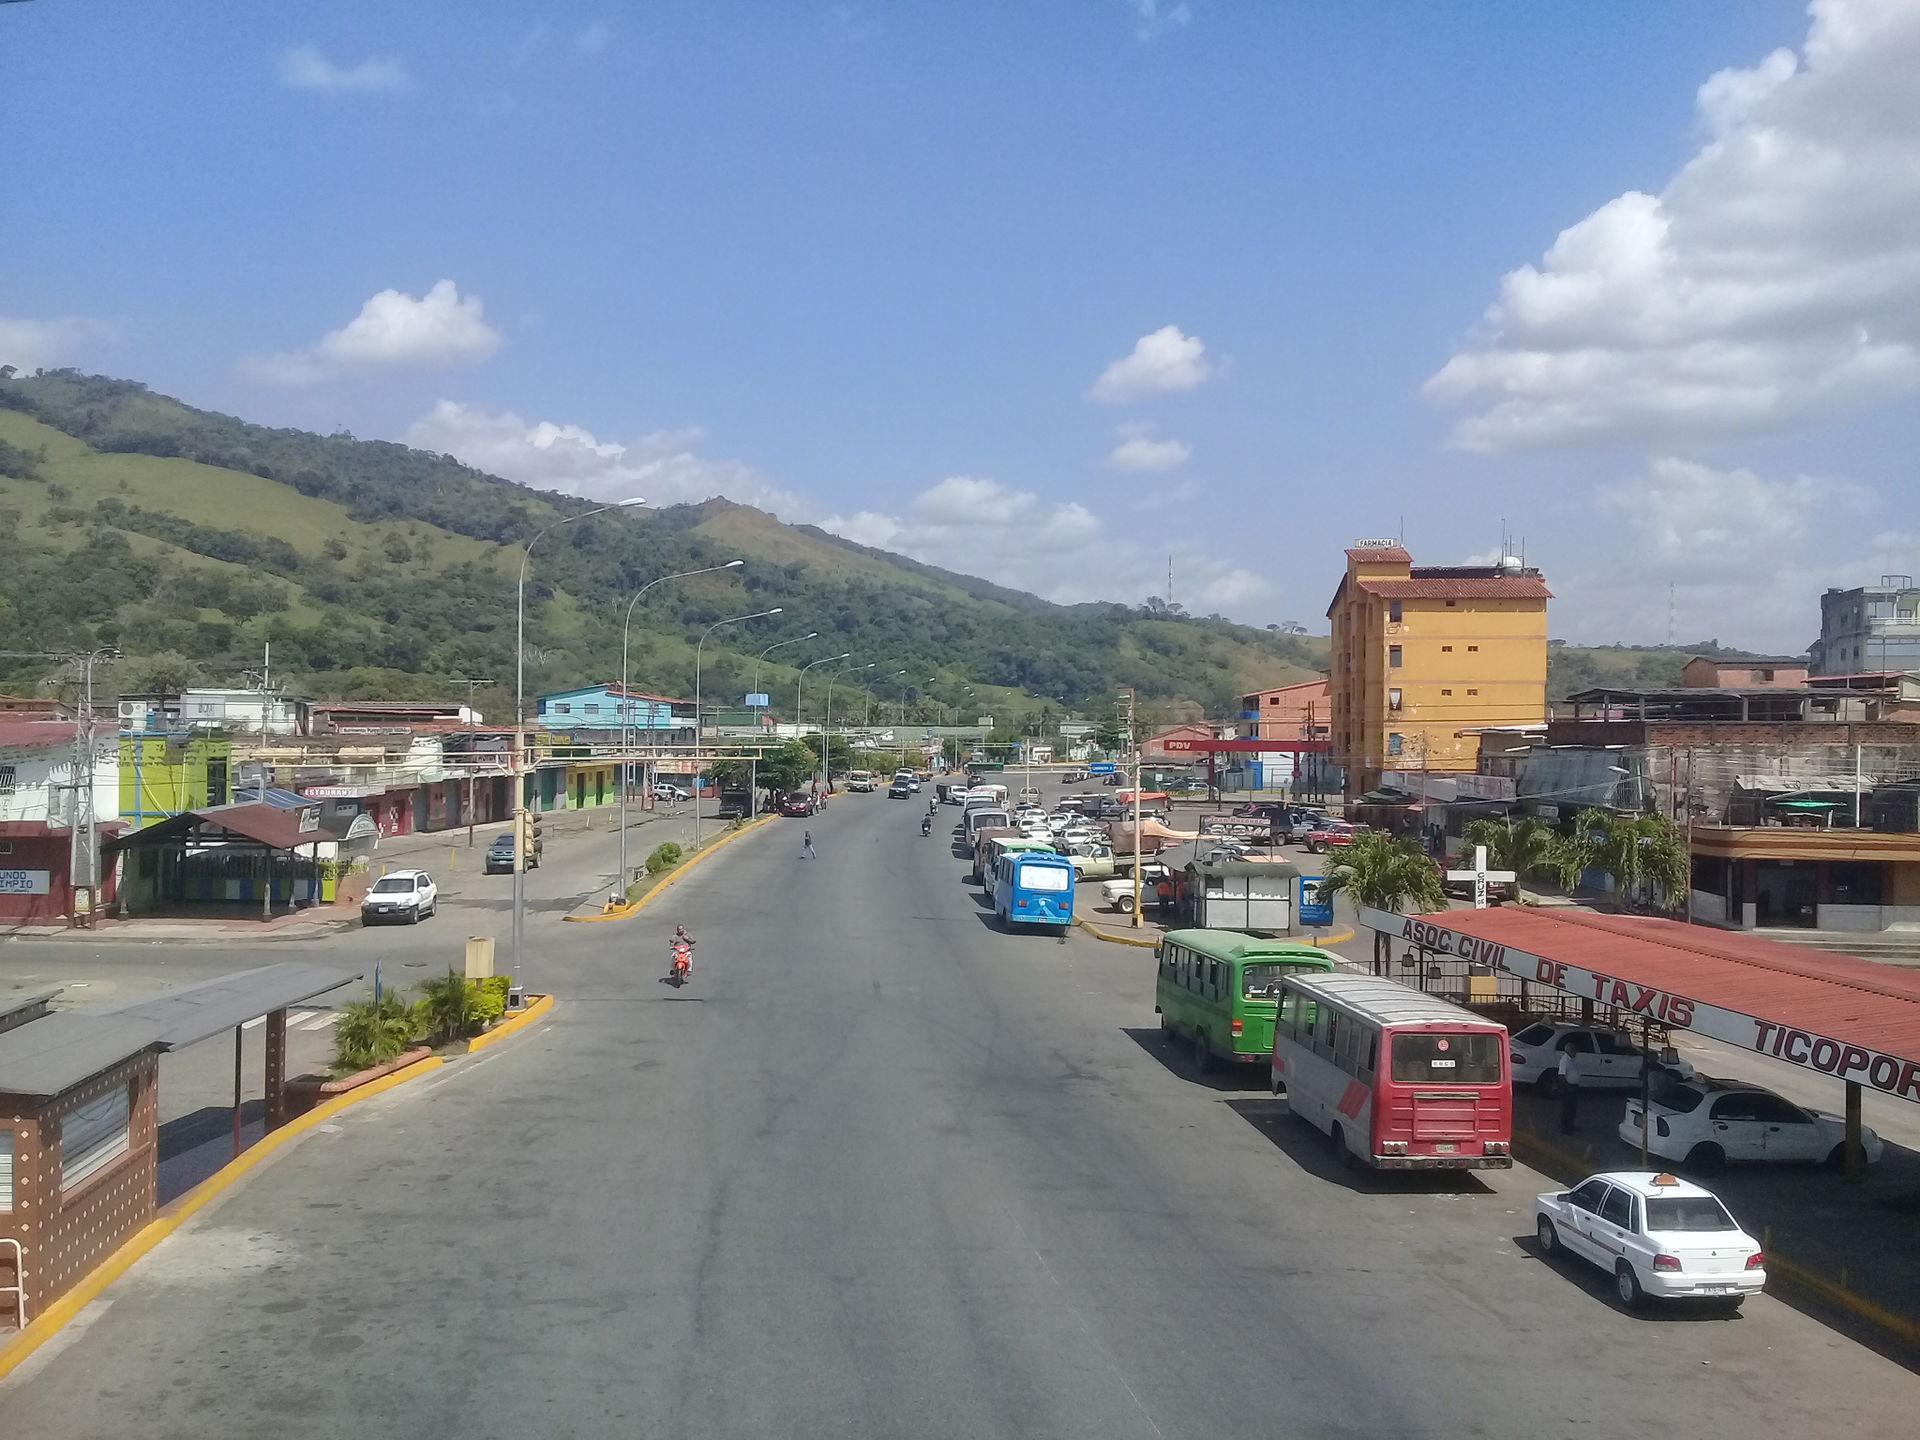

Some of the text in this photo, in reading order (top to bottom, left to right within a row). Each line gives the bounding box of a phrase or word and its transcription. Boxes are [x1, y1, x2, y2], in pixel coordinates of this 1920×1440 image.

[1169, 742, 1191, 750] PDV
[1477, 872, 1485, 897] CRUZ
[1402, 919, 1453, 951] ASOC.
[1459, 936, 1510, 971] CIVIL
[1536, 958, 1568, 988] DE
[1591, 974, 1695, 1028] TAXIS
